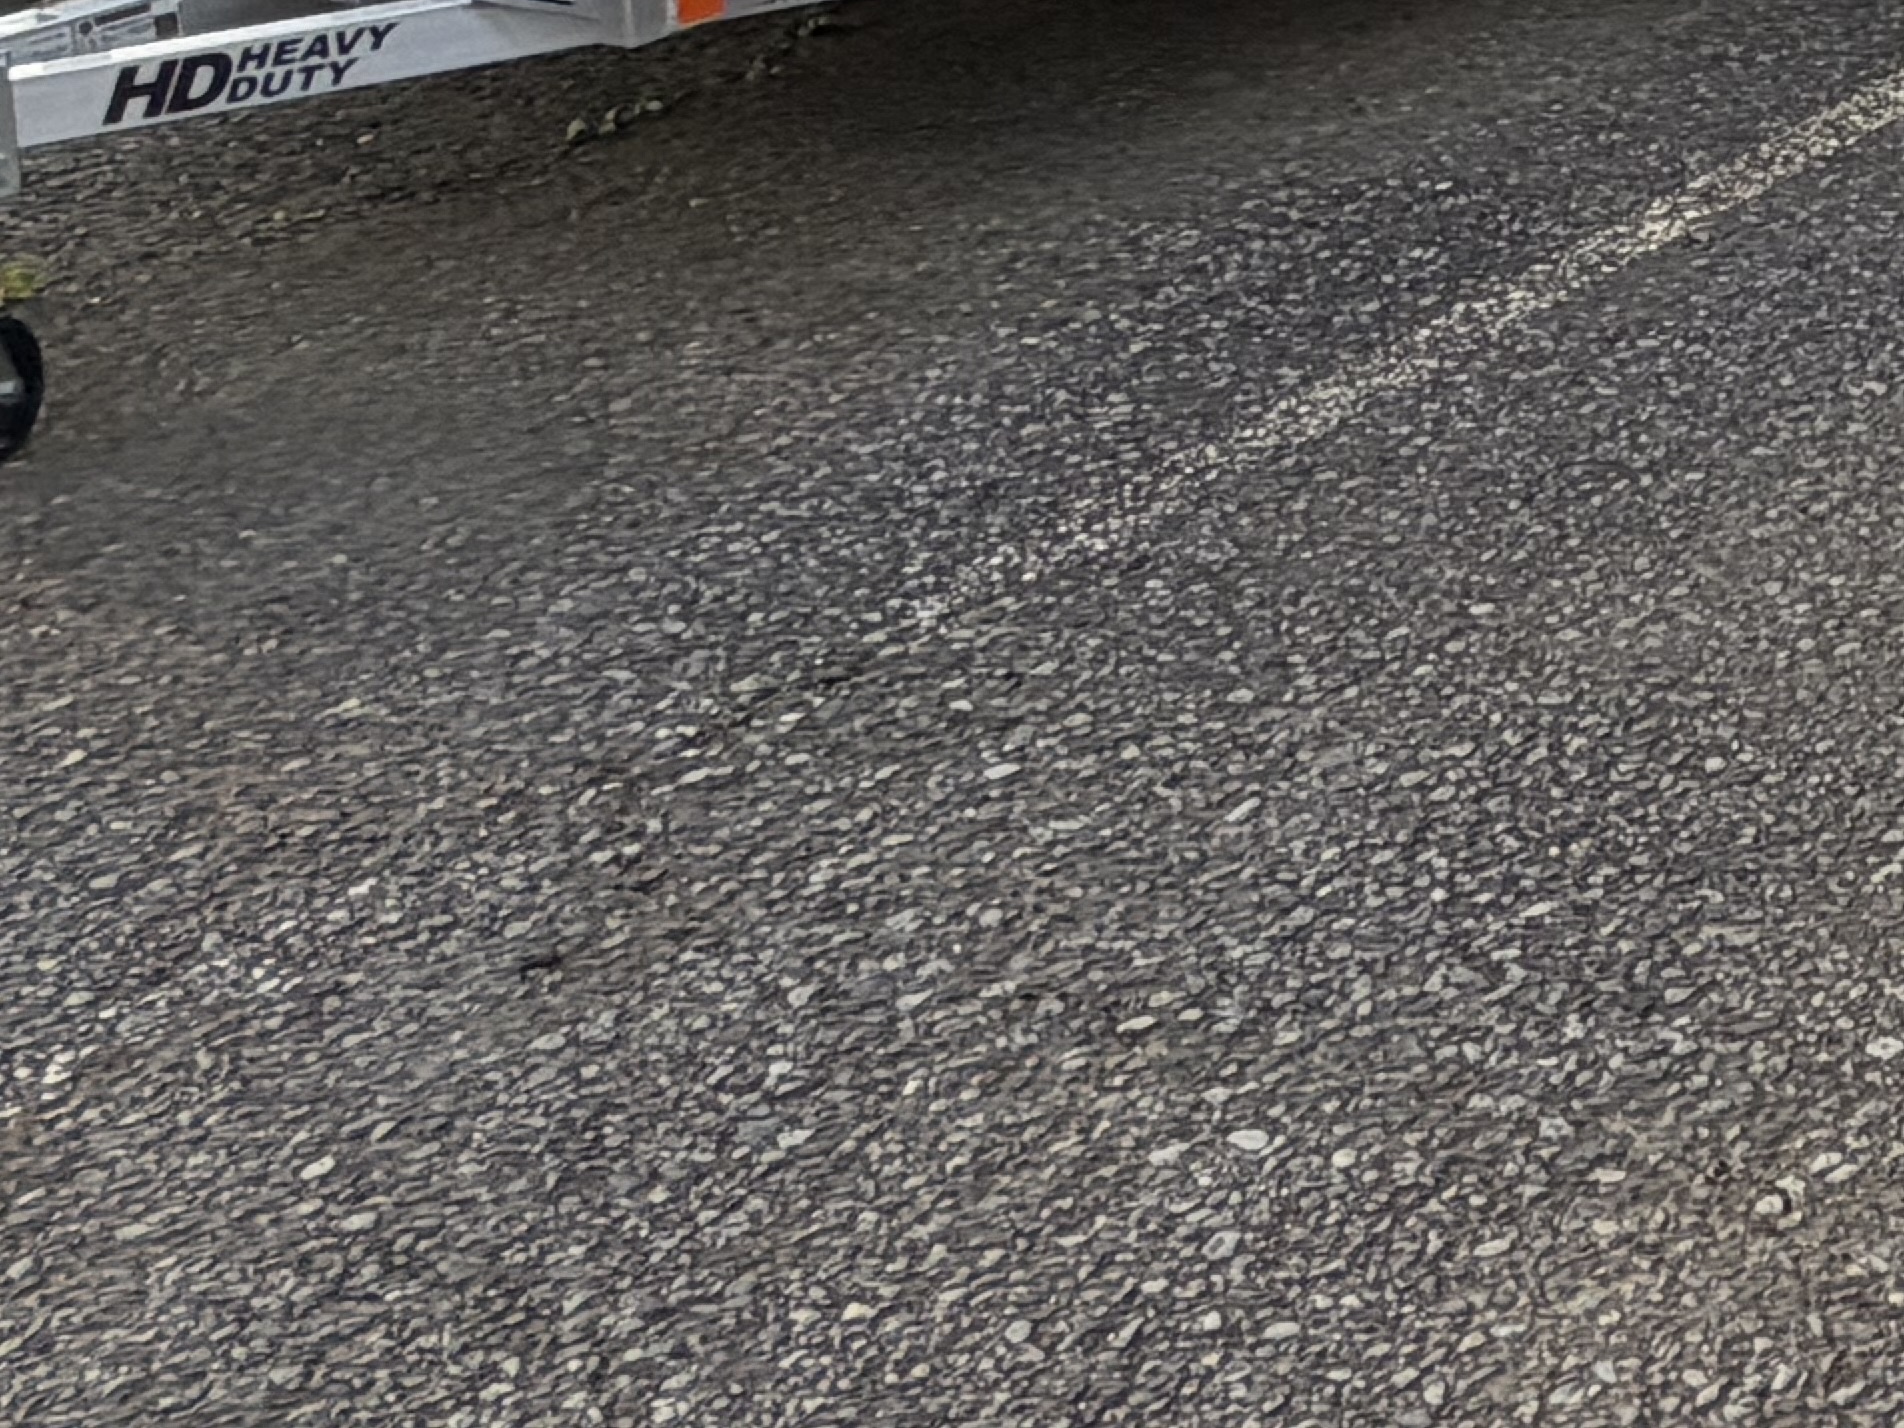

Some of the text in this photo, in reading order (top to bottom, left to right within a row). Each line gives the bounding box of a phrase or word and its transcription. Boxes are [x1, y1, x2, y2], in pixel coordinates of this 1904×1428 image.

[236, 22, 398, 72] HEAVY
[102, 52, 232, 126] HD
[226, 56, 359, 104] DUTY
